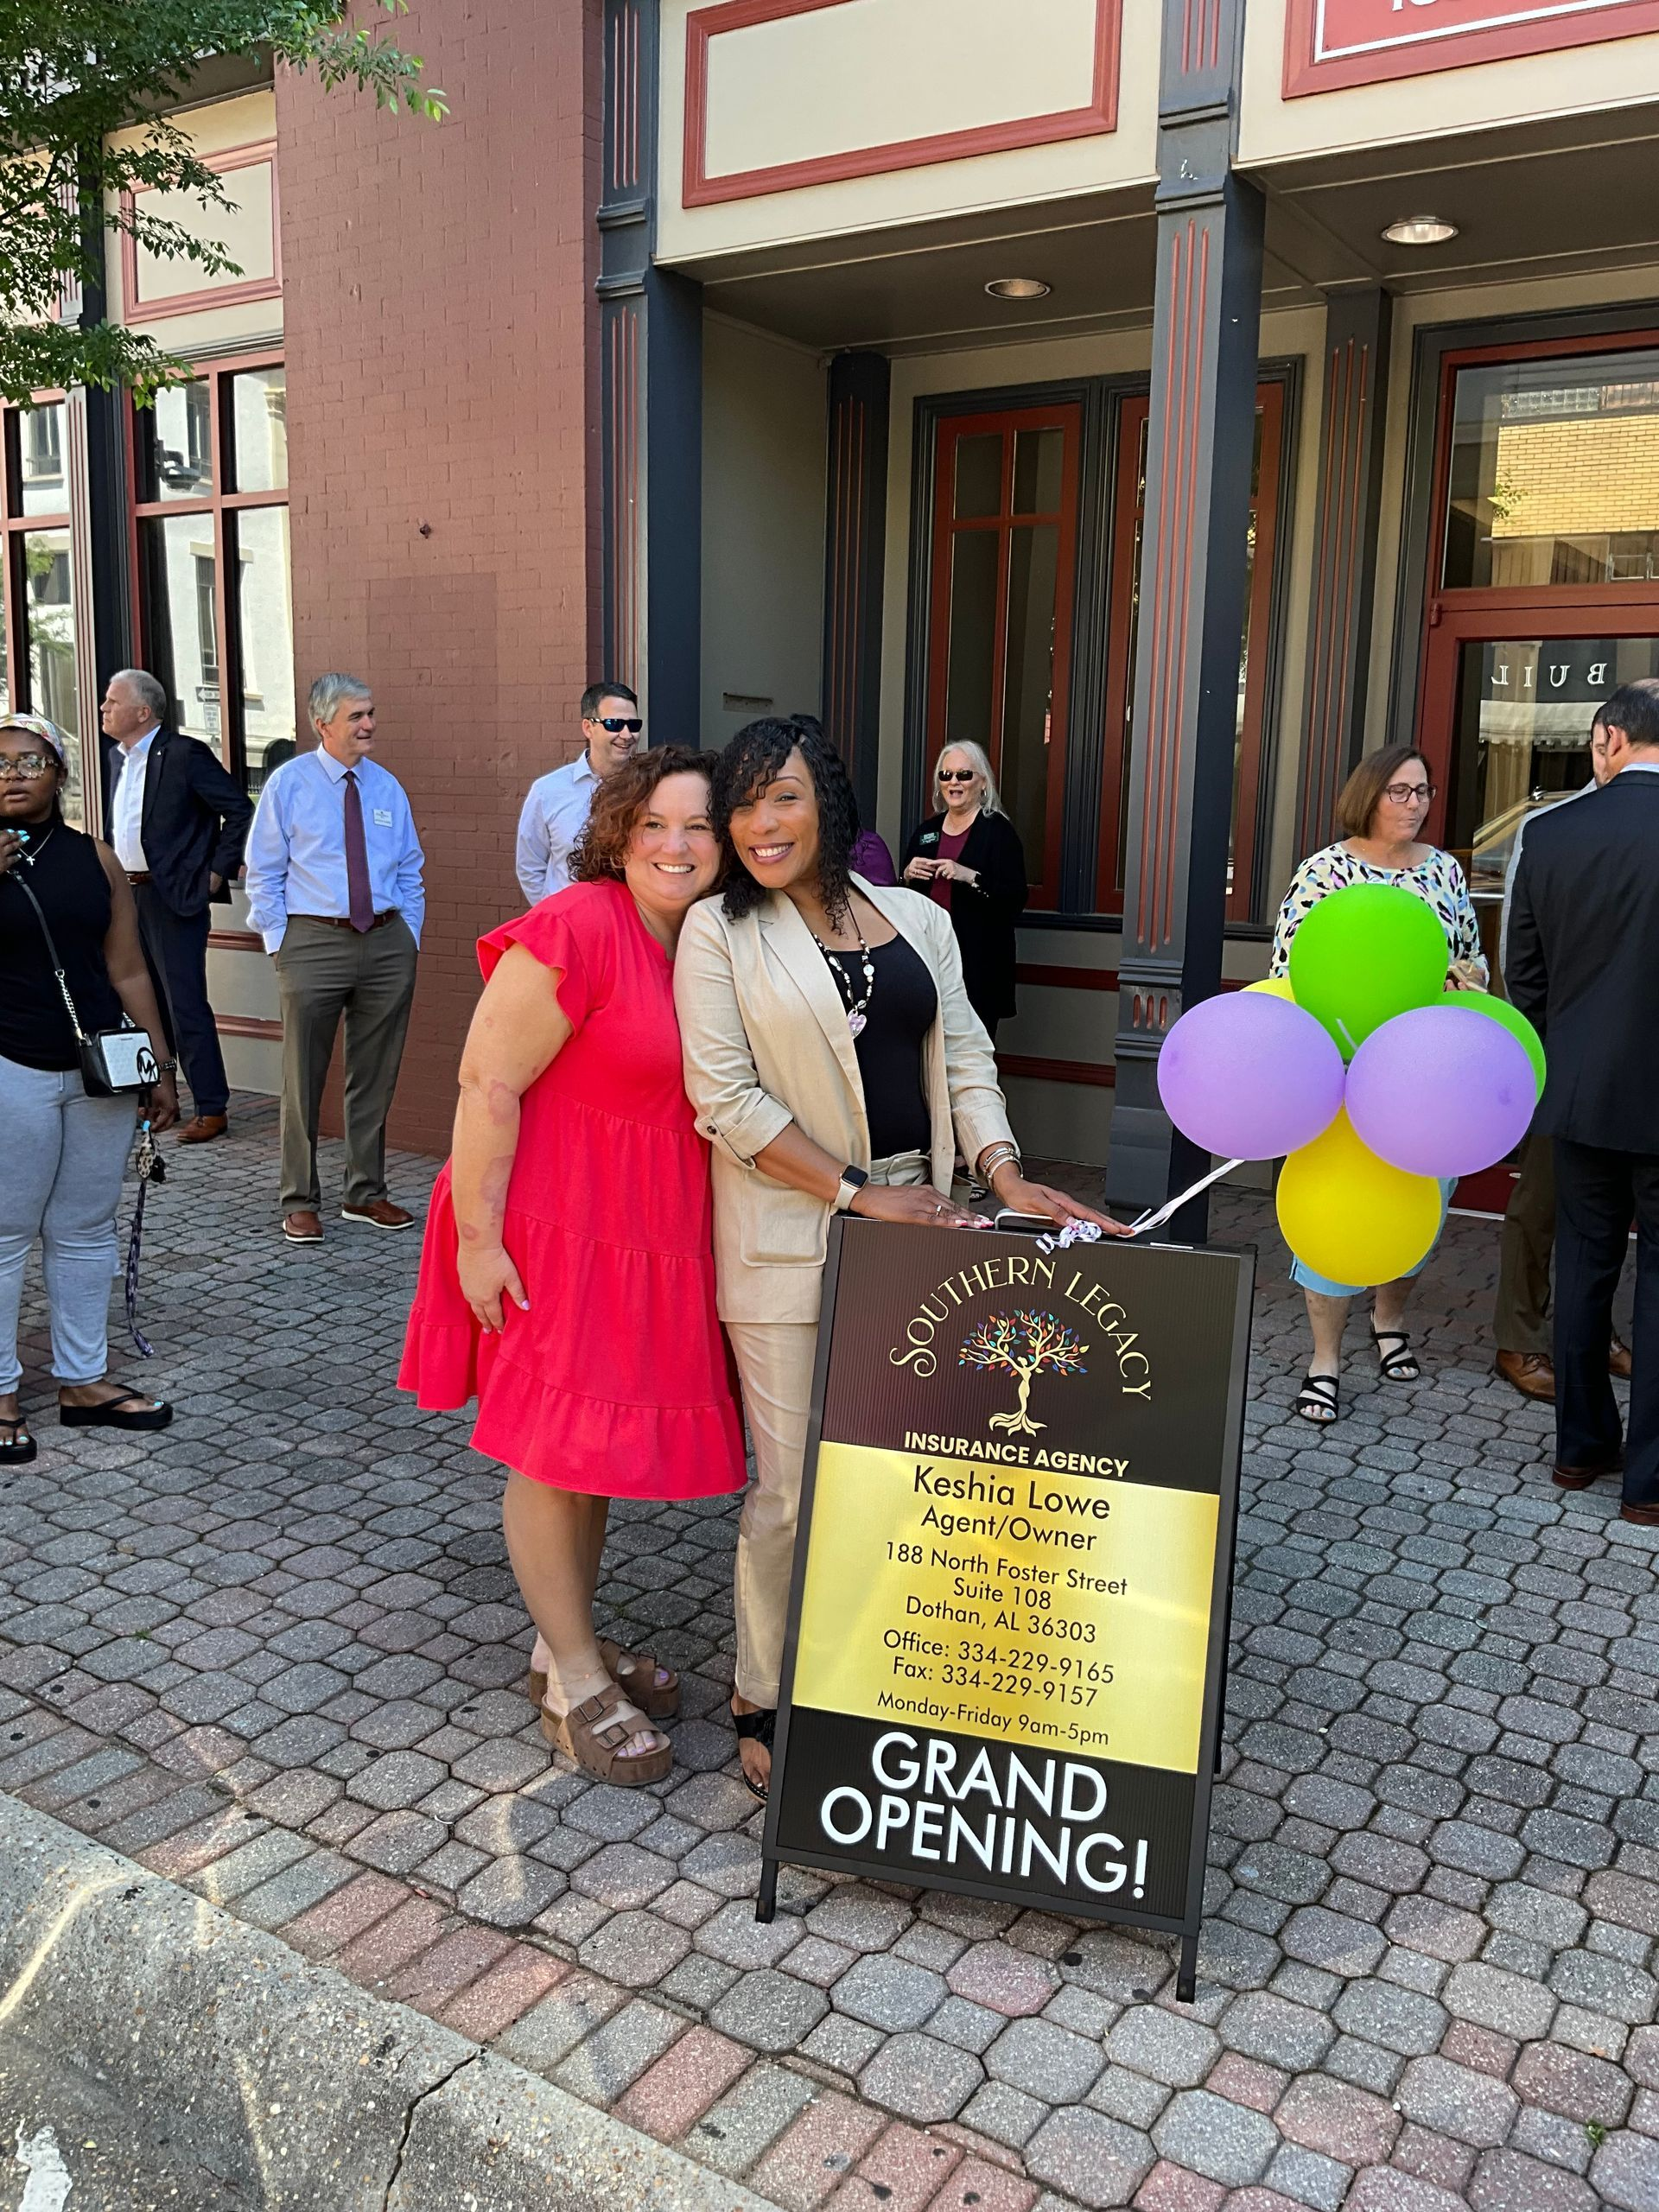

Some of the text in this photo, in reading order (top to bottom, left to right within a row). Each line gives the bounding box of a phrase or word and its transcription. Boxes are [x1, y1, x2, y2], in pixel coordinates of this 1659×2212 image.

[889, 1256, 1152, 1401] SOUTHERN LEGACY
[904, 1431, 1129, 1478] INSURANCE AGENCY
[913, 1465, 1110, 1519] Keshia Lowe
[920, 1504, 1097, 1550] Agent/Owner
[887, 1541, 1128, 1595] 188 North Foster Street
[953, 1577, 1052, 1610] Suite 108
[906, 1596, 1096, 1643] Dothan, AL 36303
[883, 1629, 1115, 1683] Office: 334-229-9165
[893, 1656, 1098, 1707] Fax: 334-229-9157
[877, 1691, 1109, 1745] Monday-Friday 9am-5pm
[872, 1731, 1108, 1821] GRAND
[820, 1785, 1148, 1899] OPENING!
